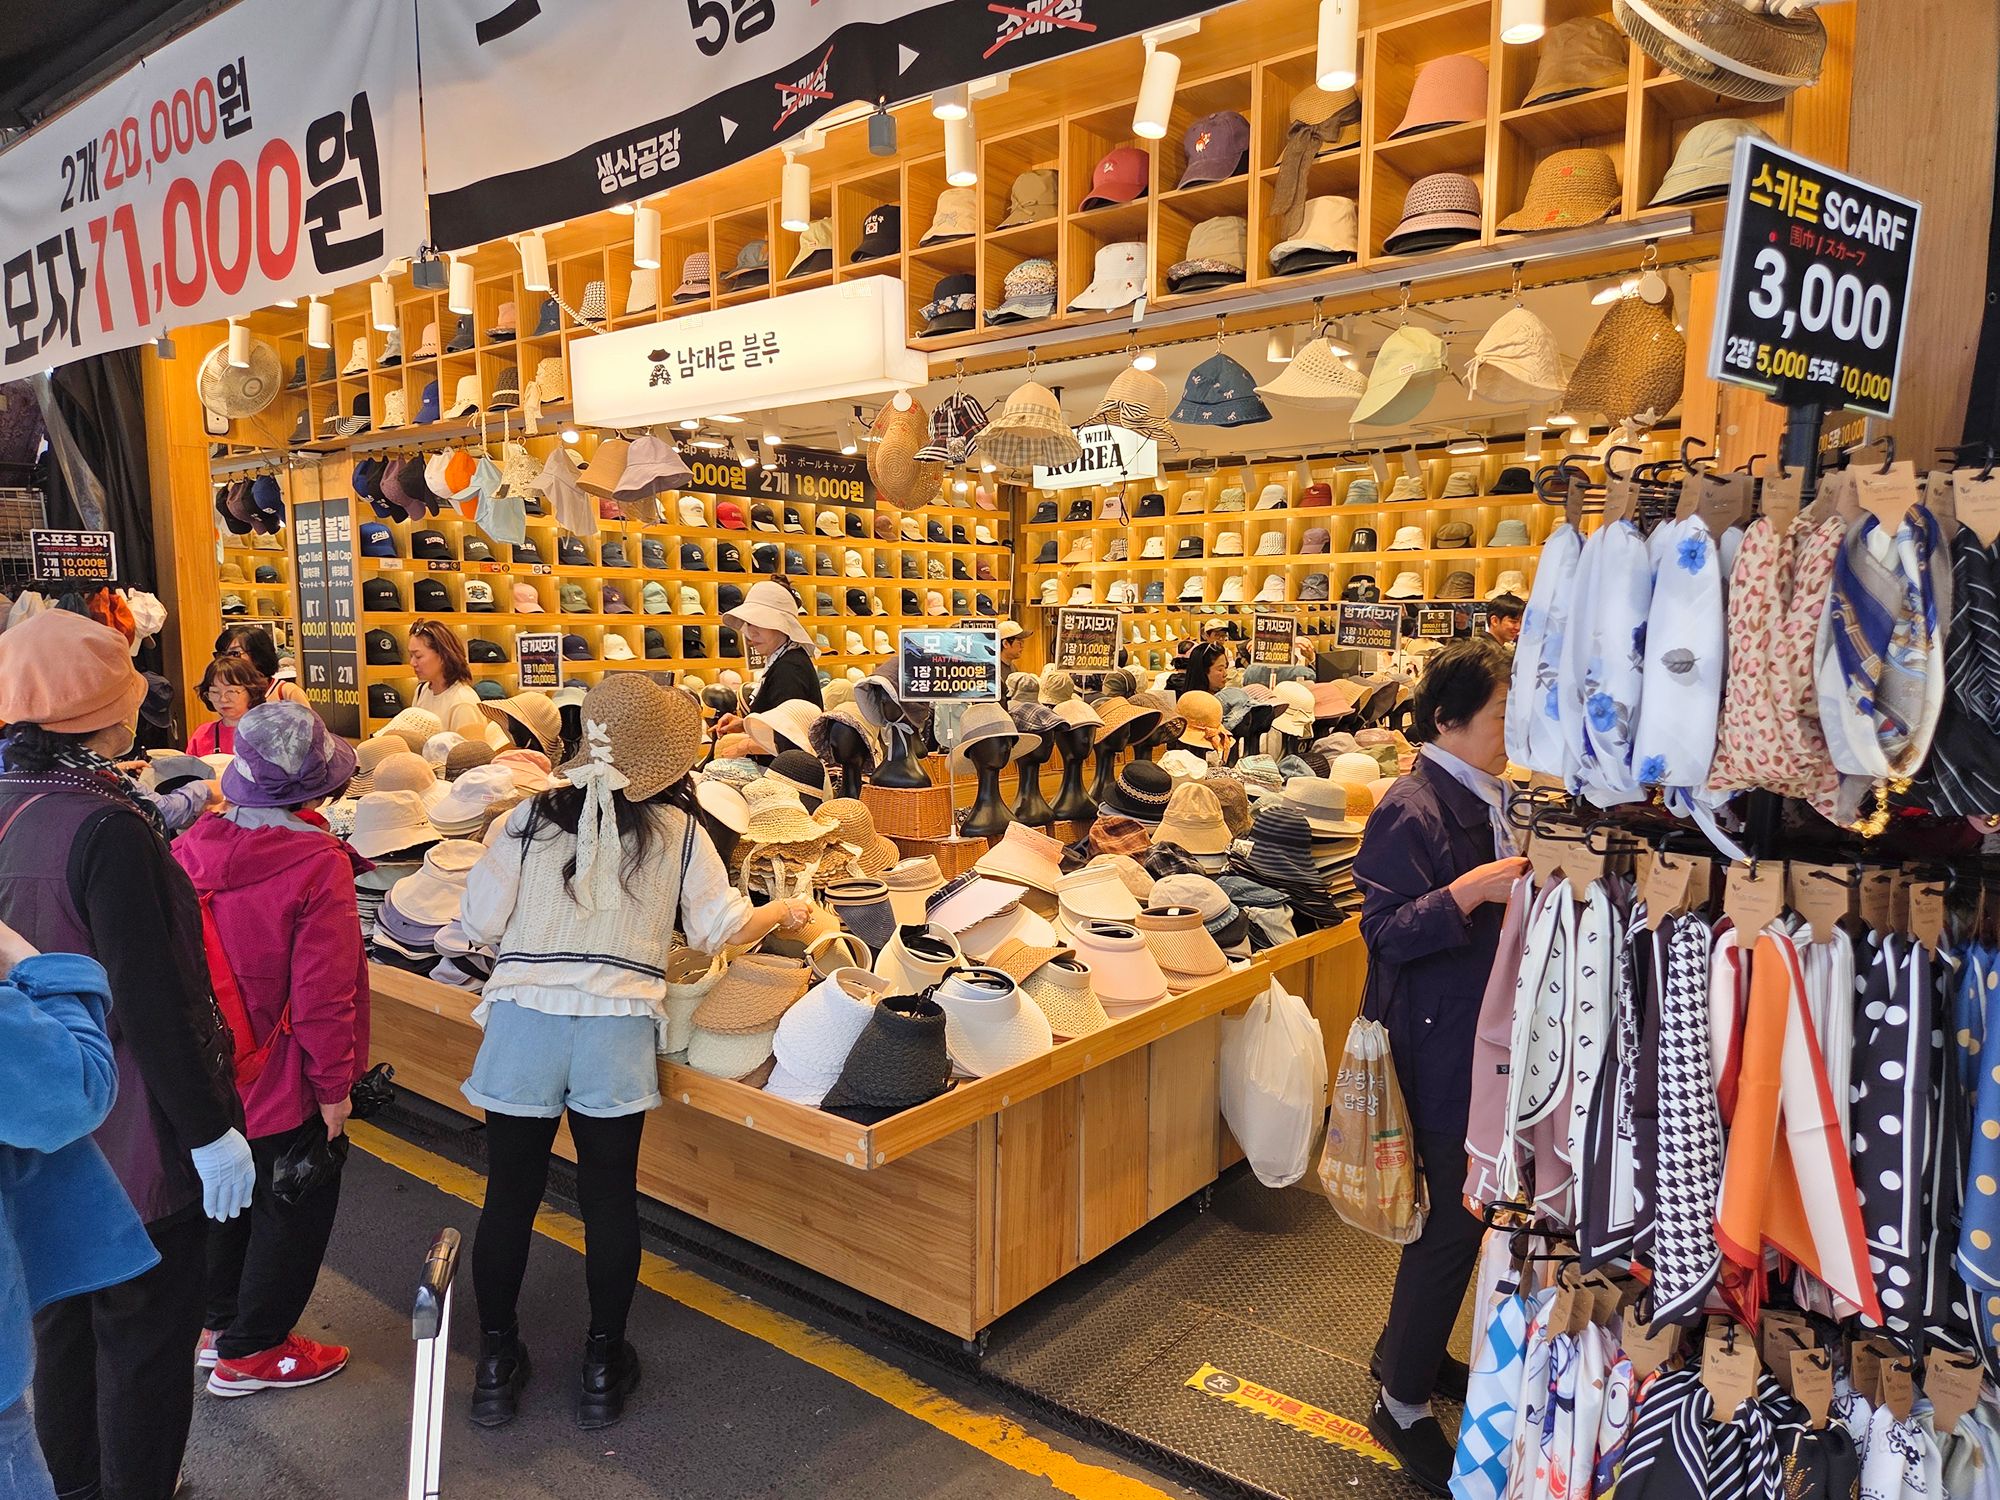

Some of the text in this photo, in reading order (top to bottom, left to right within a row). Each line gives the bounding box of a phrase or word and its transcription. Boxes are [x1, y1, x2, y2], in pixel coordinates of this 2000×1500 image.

[60, 55, 252, 213] 2개 20,000원
[596, 127, 682, 196] 생산공장
[1749, 162, 1908, 252] 스카프 SCARF
[4, 227, 86, 365] 모자
[1748, 247, 1892, 350] 3,000
[678, 331, 780, 378] 남대문 블루
[1725, 336, 1892, 403] 2장 5,000 5장 10,000
[1085, 430, 1111, 443] WITH
[676, 440, 697, 456] Cap
[760, 470, 864, 503] 2개 18,000원
[325, 516, 351, 542] 볼캡
[37, 533, 108, 547] 스포츠 모자
[43, 557, 107, 568] 1개 10,000원
[327, 550, 352, 562] Ball Cap
[43, 567, 60, 577] 2개
[335, 599, 349, 617] 1개
[1344, 606, 1398, 621] 벙거지모자
[331, 622, 356, 639] 10,000
[1065, 615, 1114, 632] 벙거지모자
[1257, 618, 1292, 633] 벙거지모자
[1345, 626, 1391, 638] 1장 11,000원
[1065, 643, 1110, 655] 1장 11,000원
[1266, 642, 1289, 652] 11,000원
[1343, 635, 1391, 647] 2장 20,000원
[1062, 655, 1109, 667] 2장 20,000원
[1265, 651, 1288, 662] 20,000원
[338, 666, 353, 684] 2개
[913, 665, 986, 680] 1장 11,000원
[911, 680, 987, 693] 2장 20,000원
[334, 689, 360, 706] 18,000
[1241, 1385, 1304, 1416] 단차를
